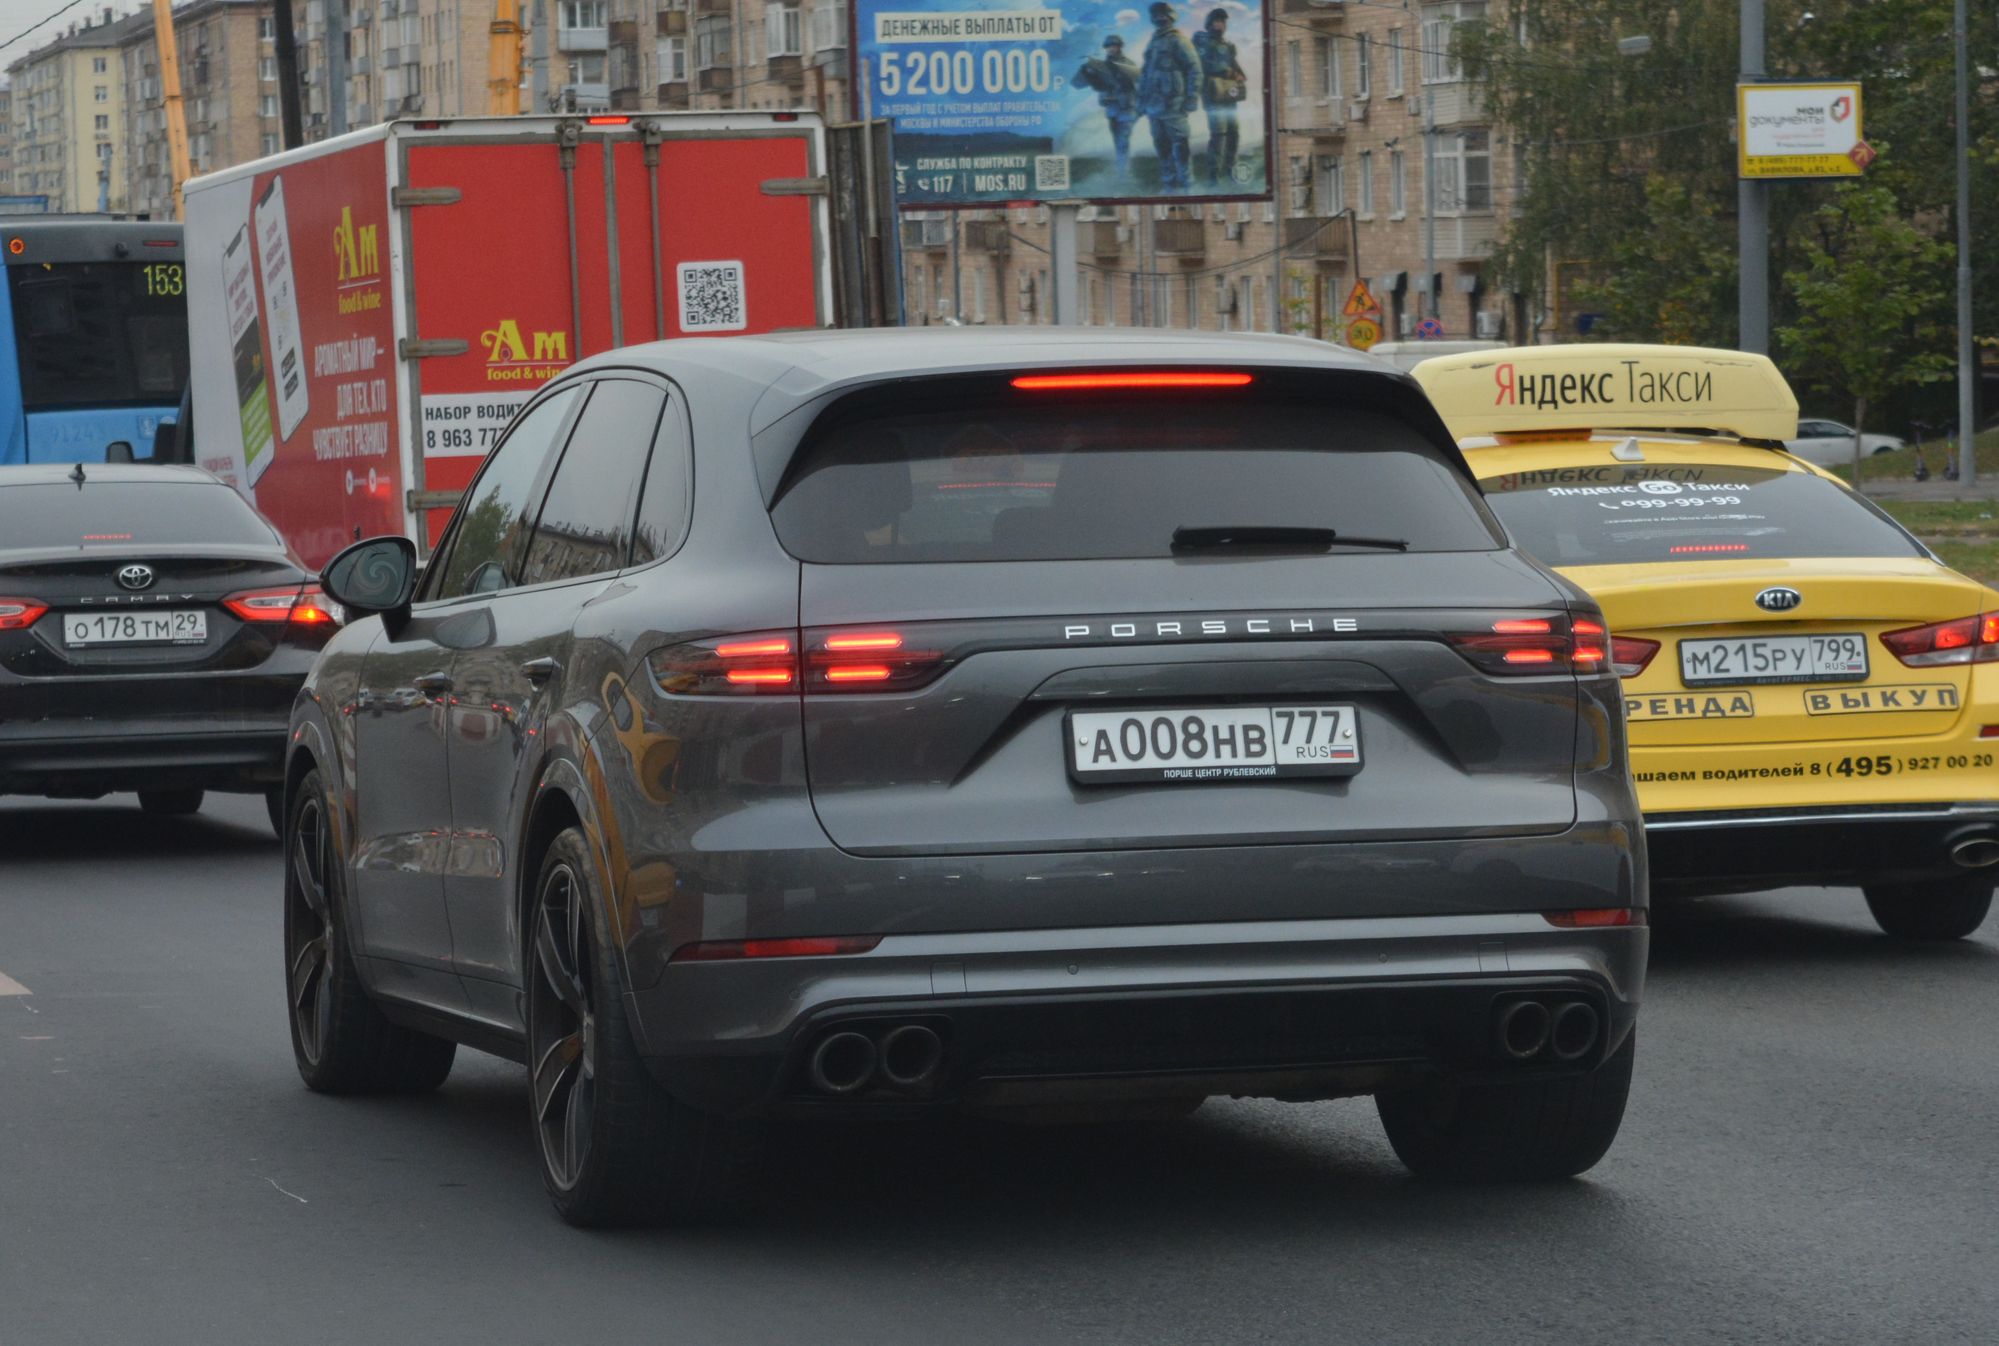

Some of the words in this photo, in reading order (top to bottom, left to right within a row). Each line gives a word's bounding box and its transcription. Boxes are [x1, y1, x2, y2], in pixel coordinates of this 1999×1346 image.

[881, 19, 961, 38] ДЕНЕЖНЫЕ
[965, 17, 1034, 35] ВЫПЛАТЫ
[1039, 16, 1055, 33] ОТ
[880, 52, 900, 96] 5
[906, 50, 974, 95] 200
[982, 49, 1050, 94] 000
[916, 158, 956, 170] СЛУЖБА
[959, 157, 971, 169] ПО
[973, 156, 1027, 169] КОНТРАКТУ
[932, 175, 954, 193] 117
[974, 174, 1027, 192] MOS.RU
[143, 264, 183, 296] 153
[487, 368, 521, 381] food
[523, 367, 533, 380] &
[536, 366, 560, 379] win
[1494, 363, 1614, 410] Яндекс
[1620, 361, 1712, 403] Такси
[425, 405, 472, 421] НАБОР
[477, 403, 523, 421] ВОДИТ
[427, 430, 436, 449] 8
[442, 428, 472, 448] 963
[478, 427, 506, 447] 77
[1547, 485, 1637, 497] Яндекс
[1682, 482, 1750, 492] Такси
[1763, 592, 1794, 608] KIA
[175, 613, 198, 631] 29
[1065, 618, 1358, 640] PORSCHE
[1691, 643, 1806, 675] М215РУ
[1812, 638, 1856, 662] 799
[1824, 662, 1846, 671] RUS
[1626, 697, 1750, 719] РЕНДА
[1810, 689, 1956, 711] ВЫКУП
[1092, 715, 1267, 764] А008НВ
[1275, 710, 1341, 745] 777
[1296, 745, 1329, 759] RUS
[1164, 769, 1193, 778] ПОРШЕ
[1195, 768, 1222, 779] ЦЕНТР
[1223, 766, 1276, 777] РУБЛЕВСКИЙ
[1702, 762, 1804, 780] водителей
[1810, 763, 1821, 776] 8
[1908, 757, 1940, 771] 927
[1946, 756, 1968, 768] 00
[1973, 754, 1994, 768] 20
